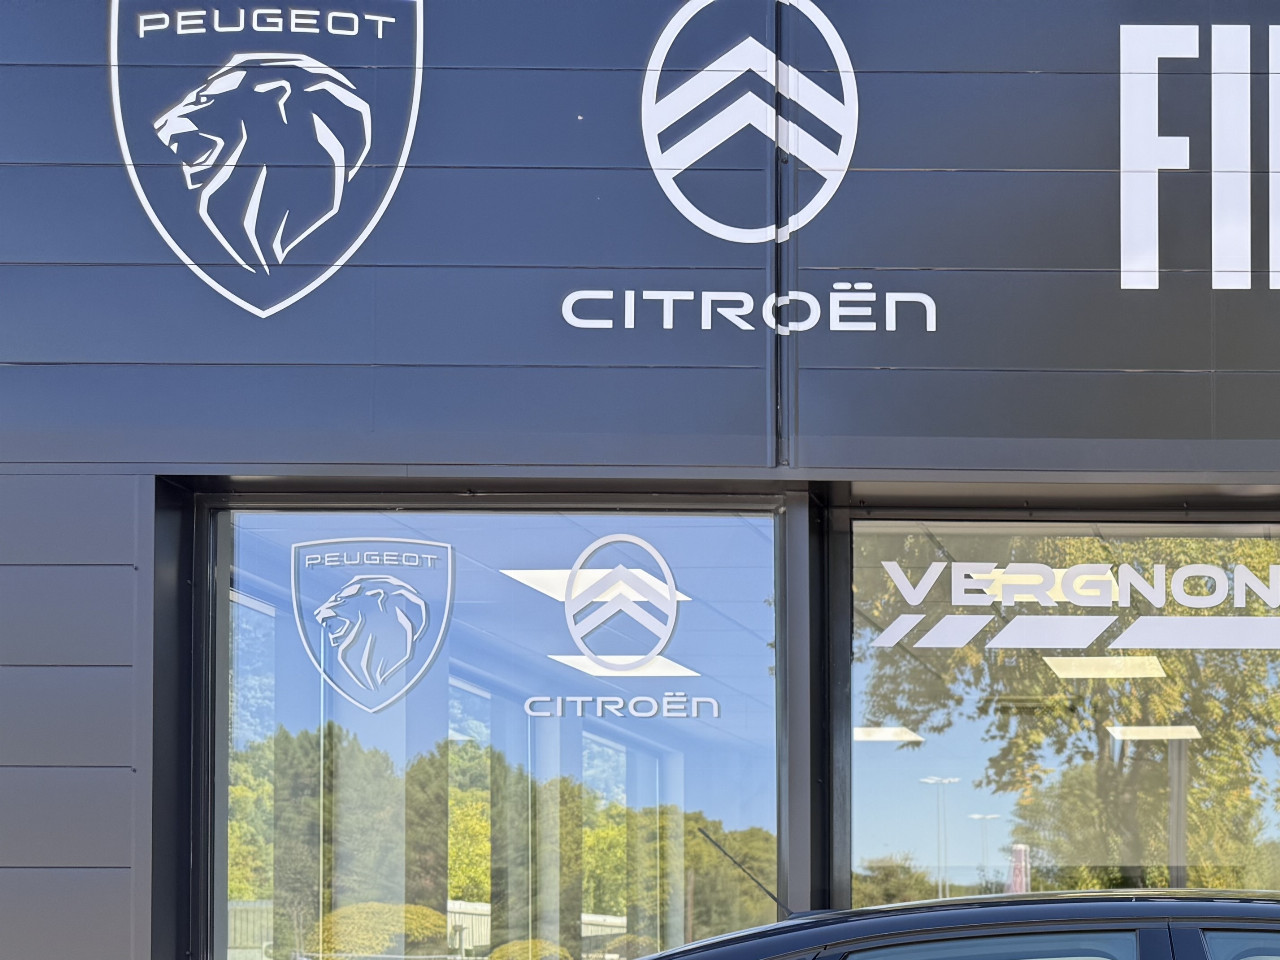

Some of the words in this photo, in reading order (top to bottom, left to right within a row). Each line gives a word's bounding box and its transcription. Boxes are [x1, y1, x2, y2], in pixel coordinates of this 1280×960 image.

[139, 8, 396, 39] PEUGEOT
[561, 282, 938, 336] CITROËN
[305, 551, 438, 568] PEUGEOT
[523, 691, 719, 719] CITROËN
